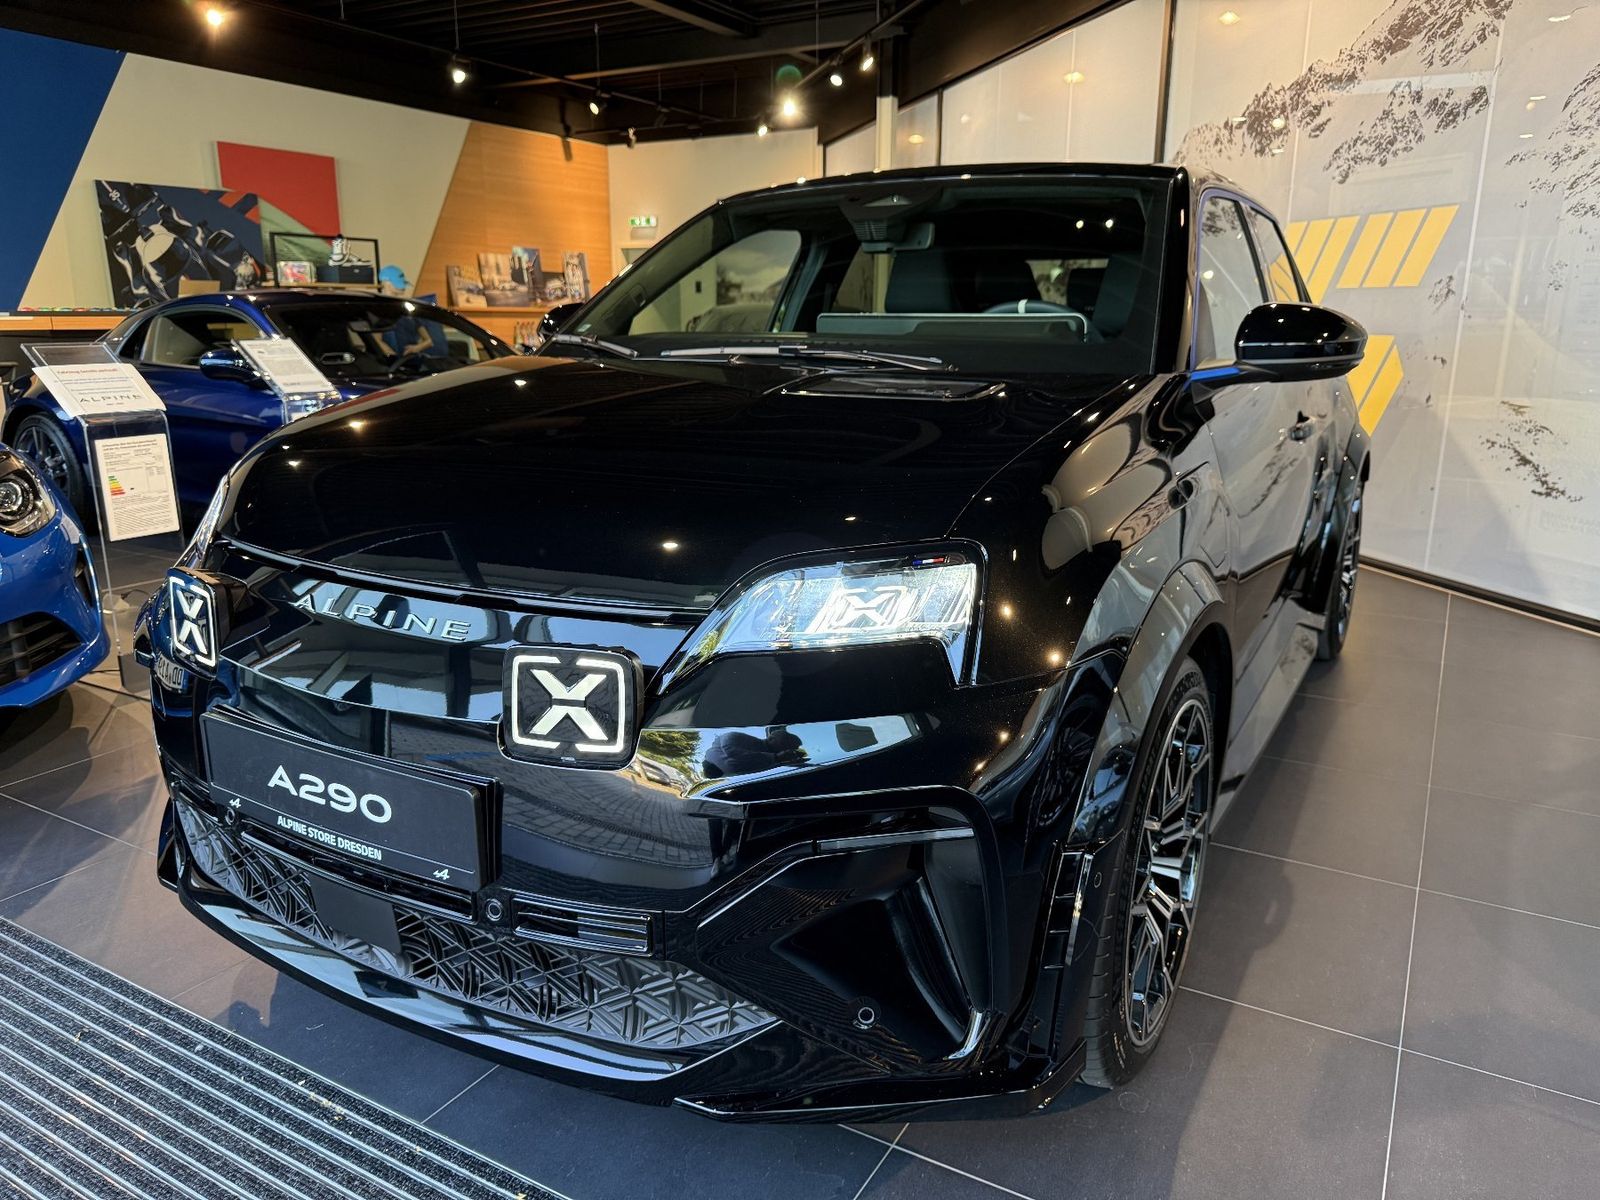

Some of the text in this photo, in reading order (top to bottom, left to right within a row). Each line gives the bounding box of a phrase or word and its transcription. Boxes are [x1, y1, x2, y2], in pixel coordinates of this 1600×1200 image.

[288, 594, 472, 641] ALPINE
[267, 764, 392, 823] A290
[277, 815, 382, 861] ALPINE STORE DRESDEN
